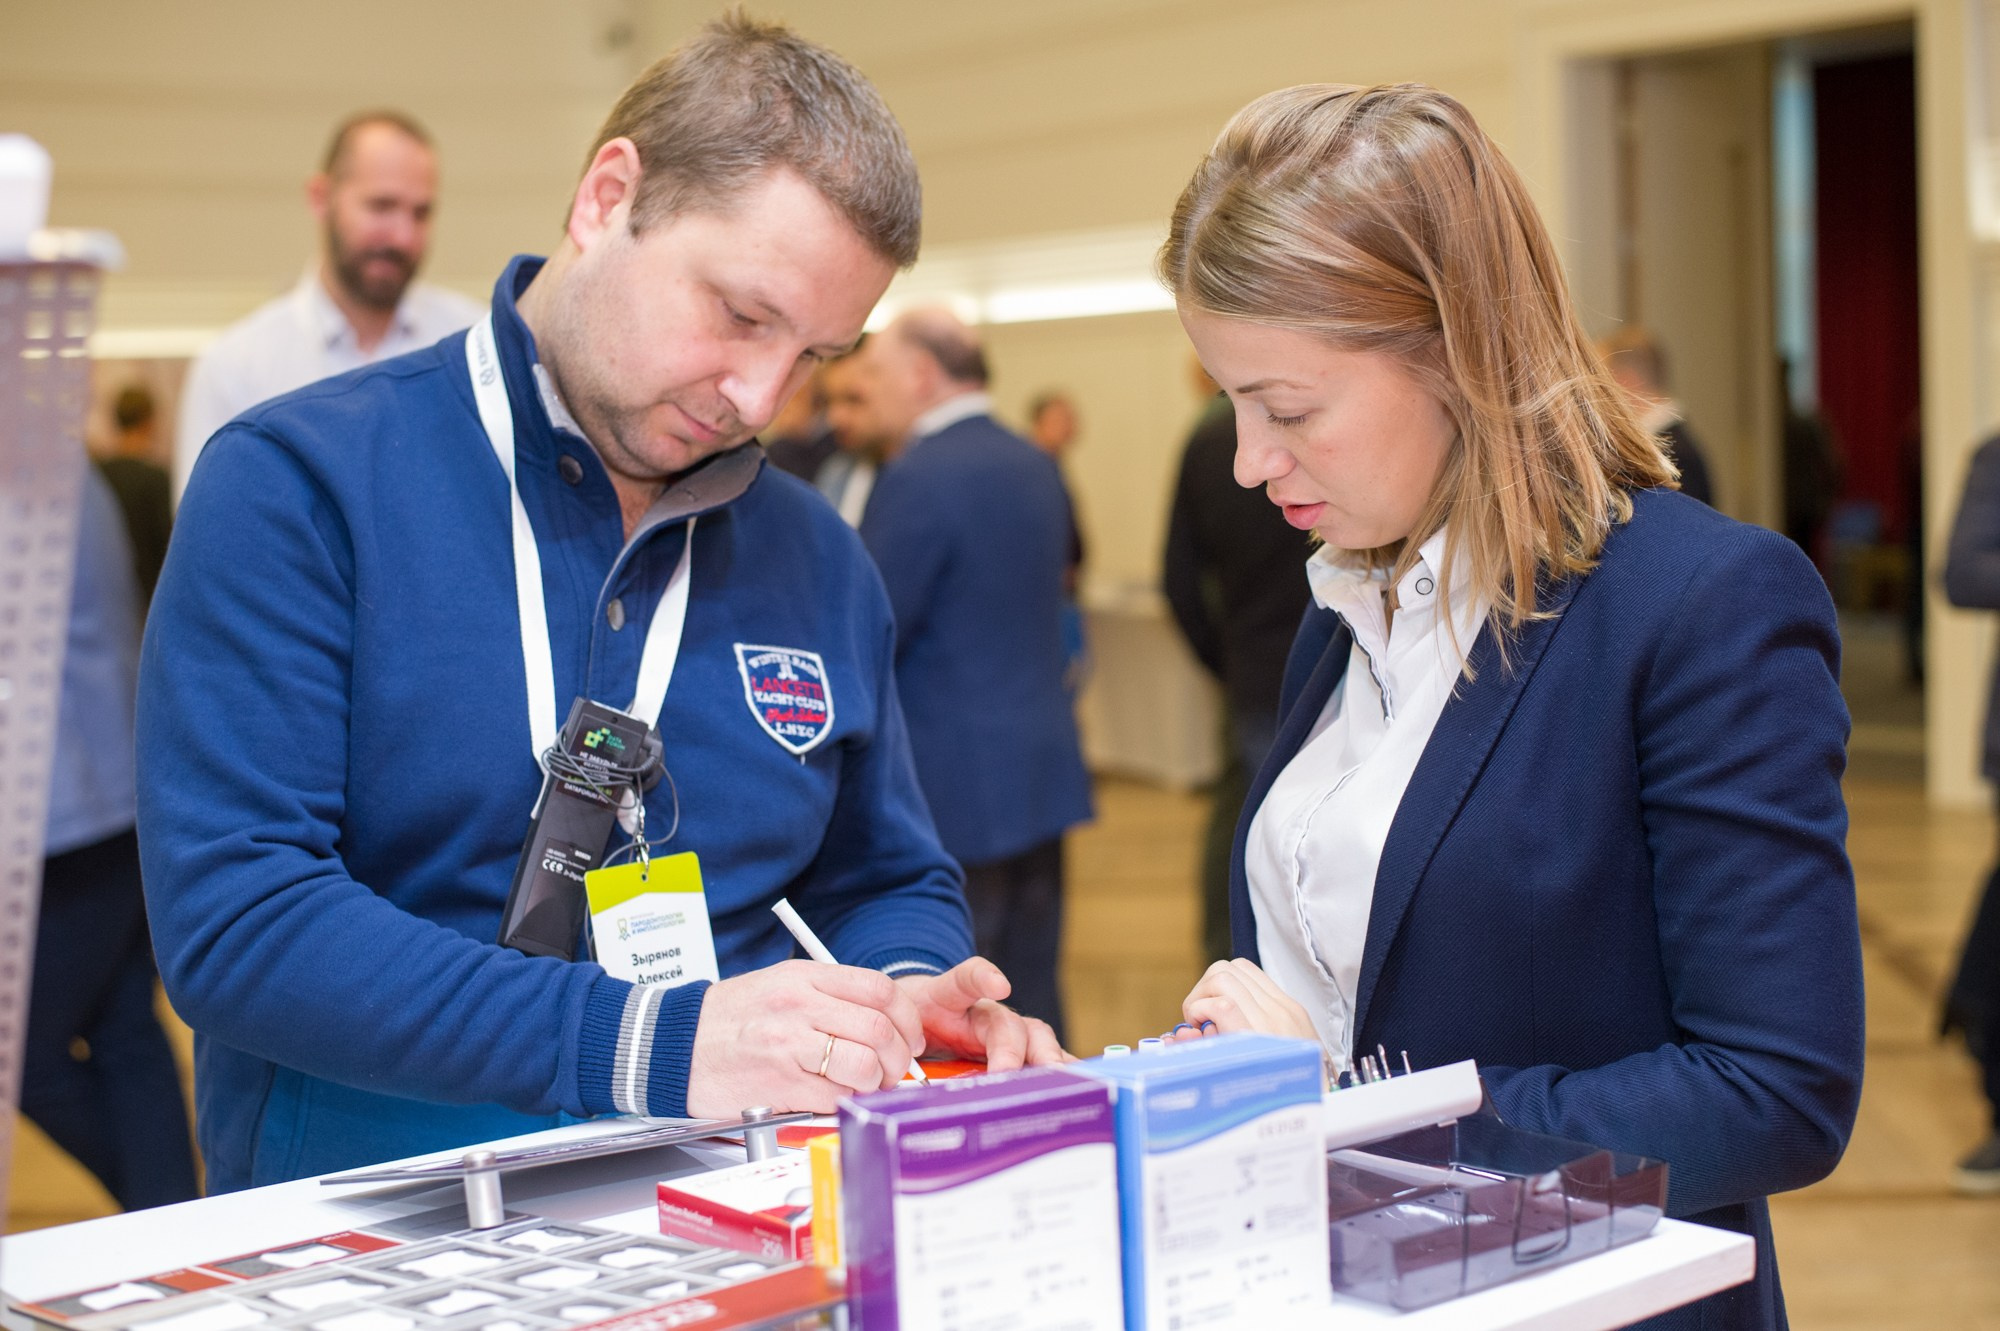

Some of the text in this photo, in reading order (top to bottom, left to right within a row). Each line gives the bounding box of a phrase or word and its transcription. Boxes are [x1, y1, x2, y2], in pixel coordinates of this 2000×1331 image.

[751, 676, 824, 700] LANCETTI
[753, 691, 826, 712] YACHT CLUB
[631, 947, 681, 966] Зырянов
[638, 964, 683, 985] Алексей
